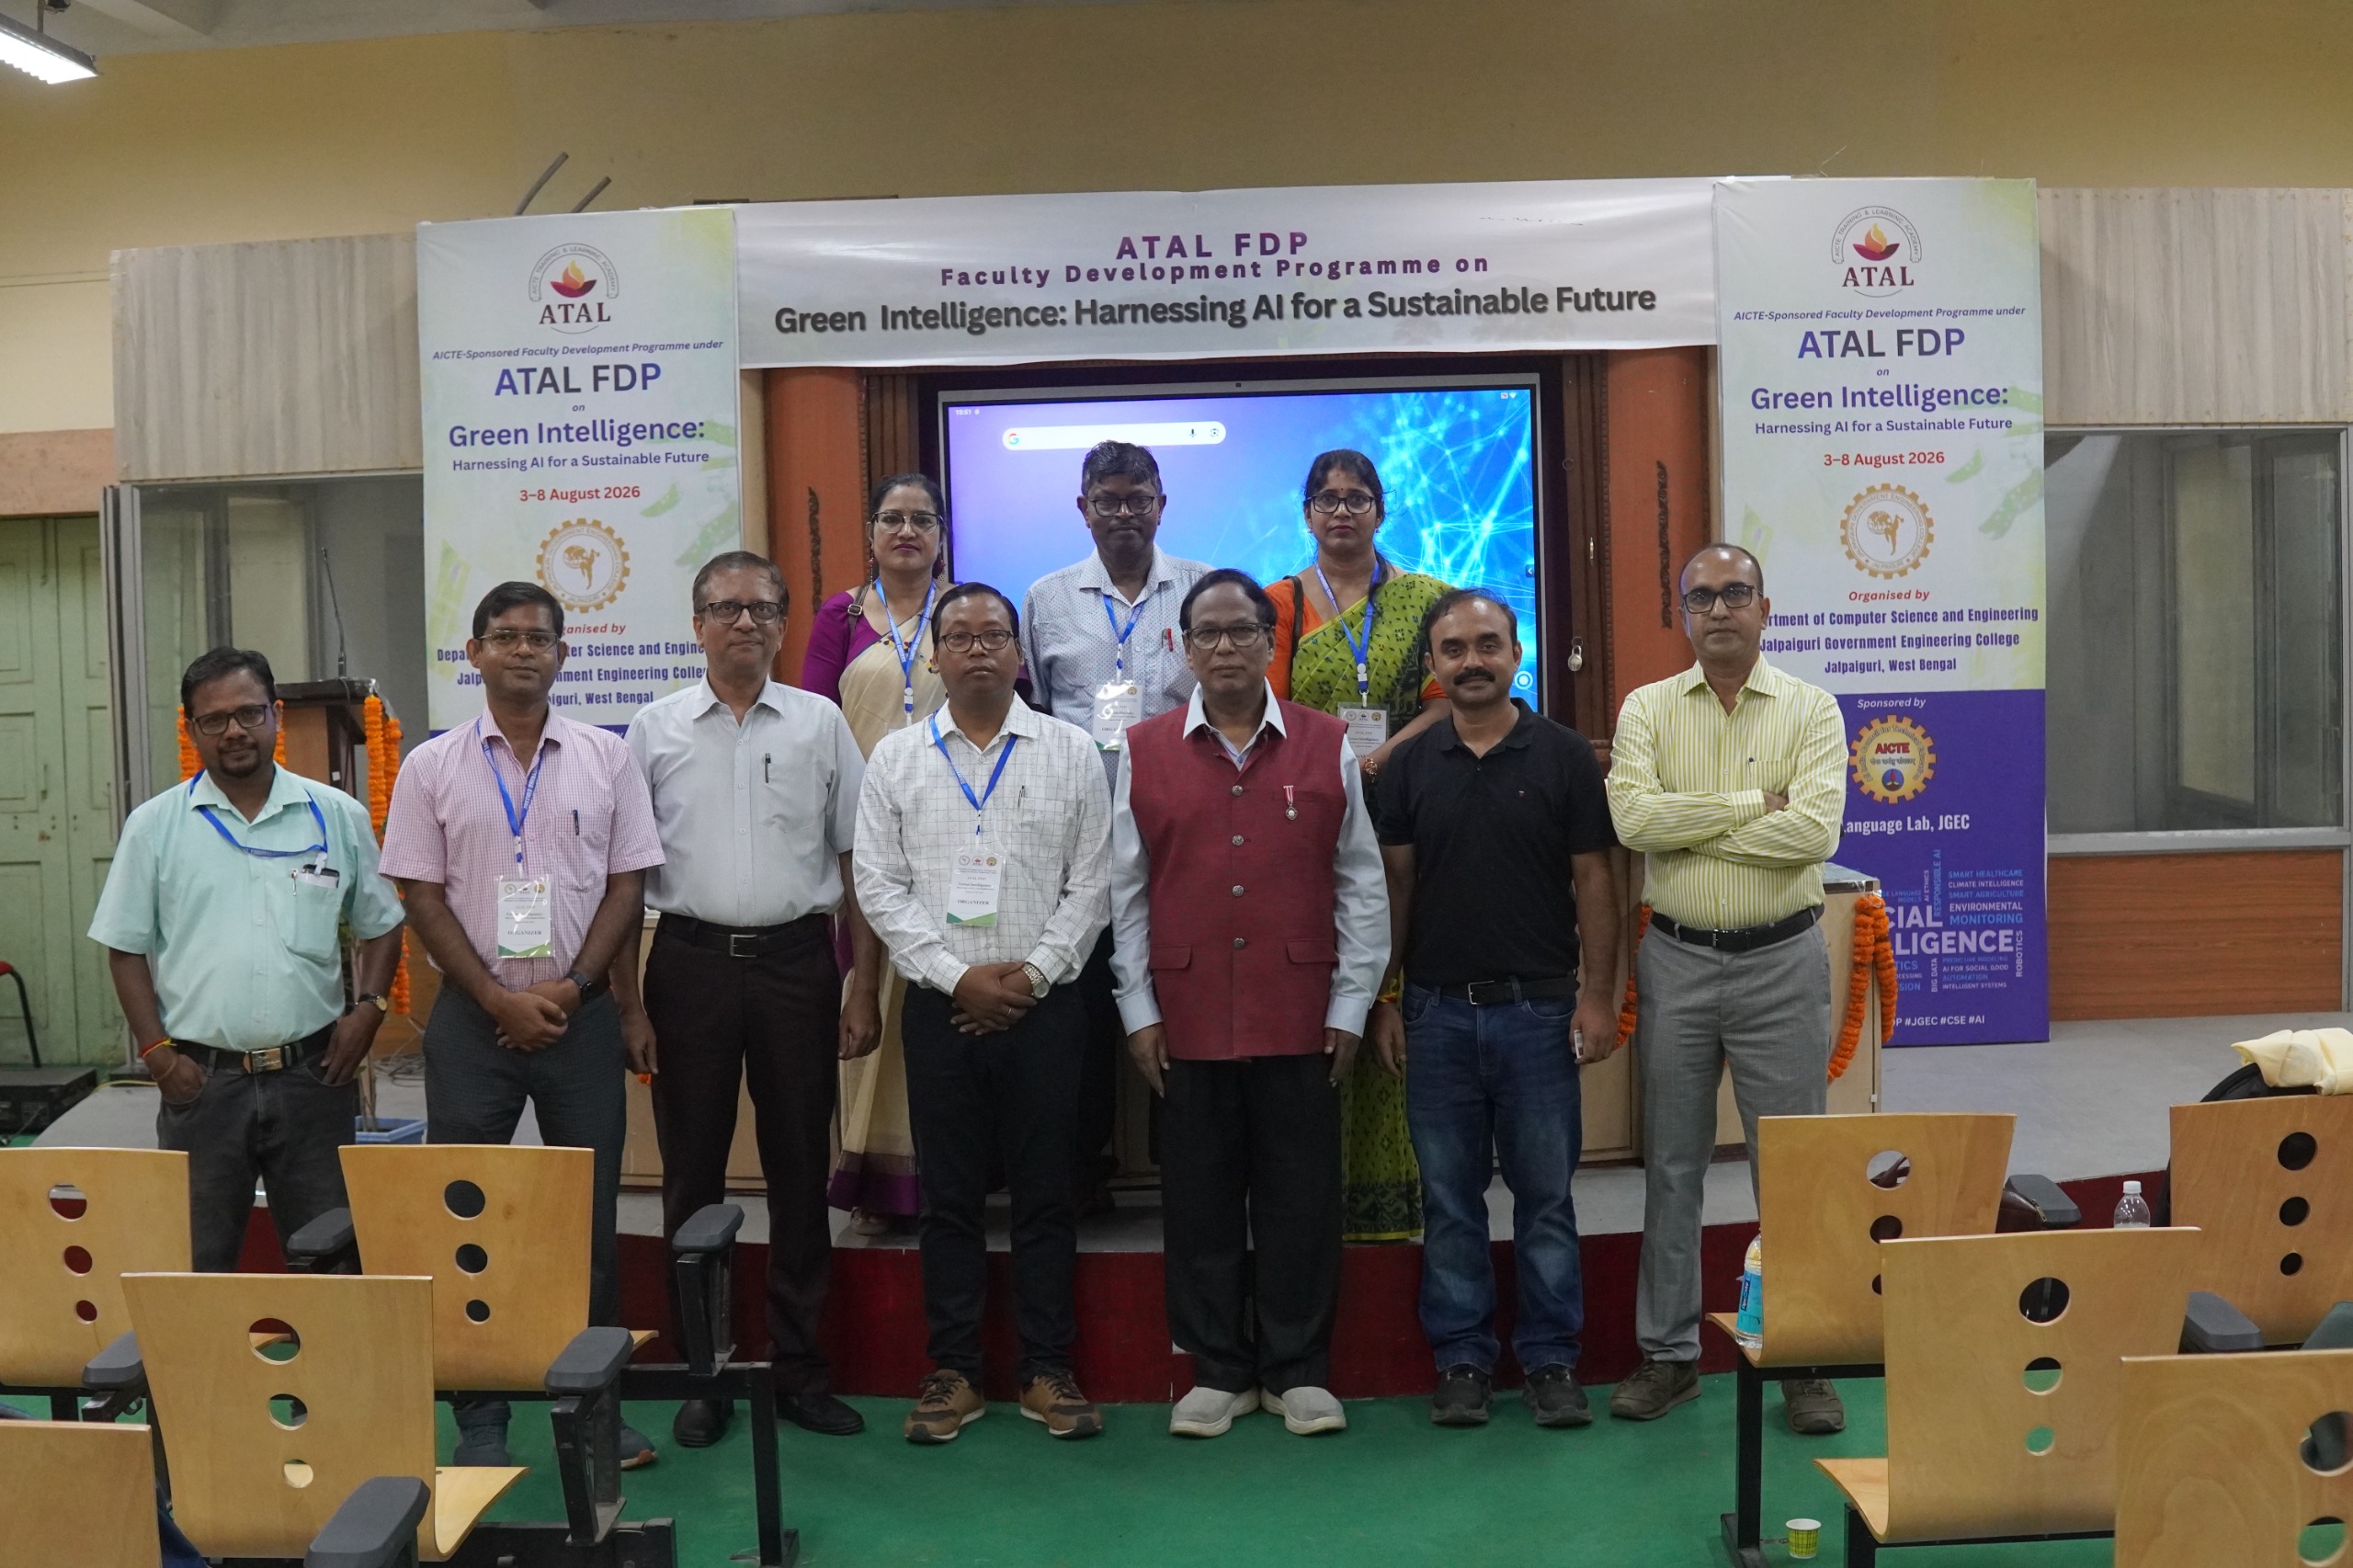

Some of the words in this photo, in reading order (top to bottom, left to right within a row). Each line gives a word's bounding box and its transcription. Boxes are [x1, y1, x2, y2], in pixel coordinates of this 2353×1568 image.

[1839, 212, 1862, 235] TRAINING
[1872, 209, 1904, 223] LEARNING
[1904, 224, 1919, 256] ACADEMY
[1116, 233, 1212, 260] ATAL
[1234, 232, 1308, 256] FDP
[940, 266, 1051, 287] Faculty
[1065, 261, 1262, 284] Development
[1277, 257, 1440, 280] Programme
[1455, 256, 1489, 273] on
[1842, 266, 1915, 287] ATAL
[539, 302, 611, 324] ATAL
[775, 306, 866, 334] Green
[881, 301, 1067, 335] Intelligence:
[1075, 294, 1246, 328] Harnessing
[1252, 292, 1284, 322] AI
[1290, 290, 1338, 319] for
[1343, 295, 1362, 318] a
[1368, 286, 1549, 316] Sustainable
[1556, 286, 1656, 313] Future
[1733, 310, 1824, 322] AICTE-Sponsored
[1824, 309, 1863, 321] Faculty
[1865, 308, 1934, 320] Development
[1936, 307, 1994, 319] Programme
[1995, 305, 2026, 316] under
[432, 347, 520, 361] AICTE-Sponsored
[521, 345, 560, 358] Faculty
[562, 343, 631, 357] Development
[631, 341, 690, 354] Programme
[692, 339, 724, 350] under
[1797, 329, 1885, 358] ATAL
[1896, 327, 1965, 357] FDP
[494, 366, 581, 396] ATAL
[592, 362, 661, 392] FDP
[1876, 368, 1890, 377] on
[1751, 387, 1833, 410] Green
[1841, 383, 2008, 413] Intelligence:
[572, 403, 585, 412] on
[449, 425, 529, 448] Green
[537, 418, 705, 447] Intelligence:
[1756, 421, 1832, 436] Harnessing
[1835, 420, 1848, 432] AI
[1852, 420, 1872, 432] for
[1875, 422, 1883, 431] a
[1886, 417, 1965, 431] Sustainable
[1969, 416, 2013, 429] Future
[452, 457, 528, 472] Harnessing
[530, 456, 545, 468] AI
[547, 455, 568, 468] for
[570, 457, 579, 467] a
[581, 452, 661, 466] Sustainable
[664, 450, 710, 464] Future
[1853, 452, 1905, 468] August
[1908, 451, 1945, 464] 2026
[550, 487, 601, 504] August
[604, 486, 641, 498] 2026
[1848, 590, 1912, 603] Organised
[1914, 589, 1930, 601] by
[1768, 611, 1809, 627] rtment
[1813, 611, 1825, 626] of
[1829, 610, 1886, 627] Computer
[1891, 608, 1938, 624] Science
[1942, 608, 1964, 623] and
[1968, 607, 2039, 623] Engineering
[611, 623, 626, 634] by
[587, 643, 634, 657] Science
[639, 642, 661, 655] and
[1760, 636, 1820, 653] Jalpaiguri
[1824, 634, 1896, 651] Government
[1901, 632, 1972, 649] Engineering
[1975, 631, 2020, 647] College
[597, 666, 668, 682] Engineering
[673, 665, 706, 679] Colle
[1824, 658, 1885, 674] Jalpaiguri,
[1888, 658, 1916, 672] West
[1919, 657, 1957, 673] Bengal
[585, 692, 612, 704] West
[616, 690, 654, 705] Bengal
[1857, 698, 1912, 710] Sponsored
[1913, 697, 1927, 709] by
[1875, 742, 1910, 754] AICTE
[1844, 819, 1903, 835] anguage
[1907, 815, 1934, 833] Lab,
[1938, 814, 1971, 830] JGEC
[1933, 848, 1941, 858] AI
[1949, 870, 1973, 879] SMART
[1976, 869, 2023, 878] HEALTHCARE
[1933, 860, 1941, 917] RESPONSIBLE
[1949, 881, 1976, 889] CLIMATE
[1978, 880, 2024, 888] INTELLIGENCE
[1949, 891, 1973, 899] SMART
[1975, 890, 2024, 898] AGRICULTURE
[1949, 902, 2023, 912] ENVIRONMENTAL
[1949, 914, 2023, 926] MONITORING
[1942, 973, 1989, 982] AUTOMATION
[1904, 1017, 1938, 1027] #JGEC
[1939, 1015, 1967, 1026] #CSE
[1968, 1015, 1985, 1024] #AI
